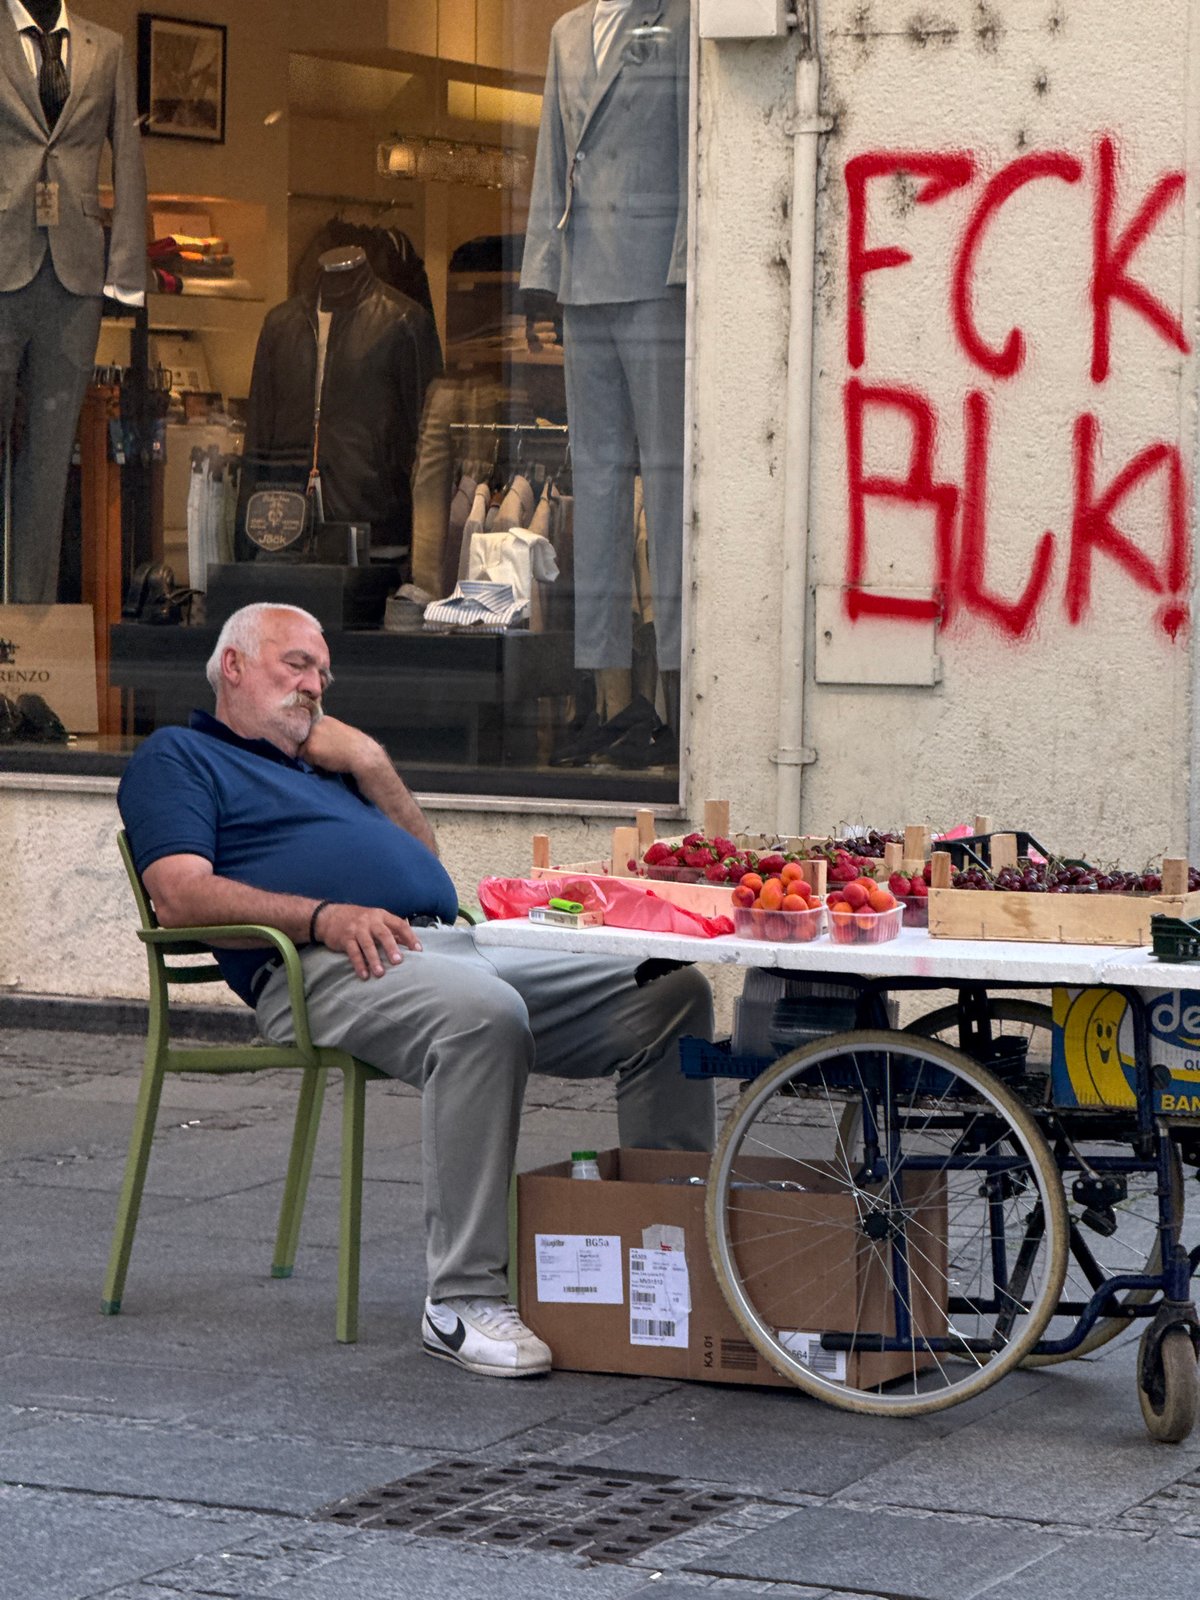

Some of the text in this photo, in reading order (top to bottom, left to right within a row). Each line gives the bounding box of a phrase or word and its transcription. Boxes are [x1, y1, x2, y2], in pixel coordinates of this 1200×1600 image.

[845, 132, 1190, 382] FCK
[704, 1336, 713, 1367] KA 01
